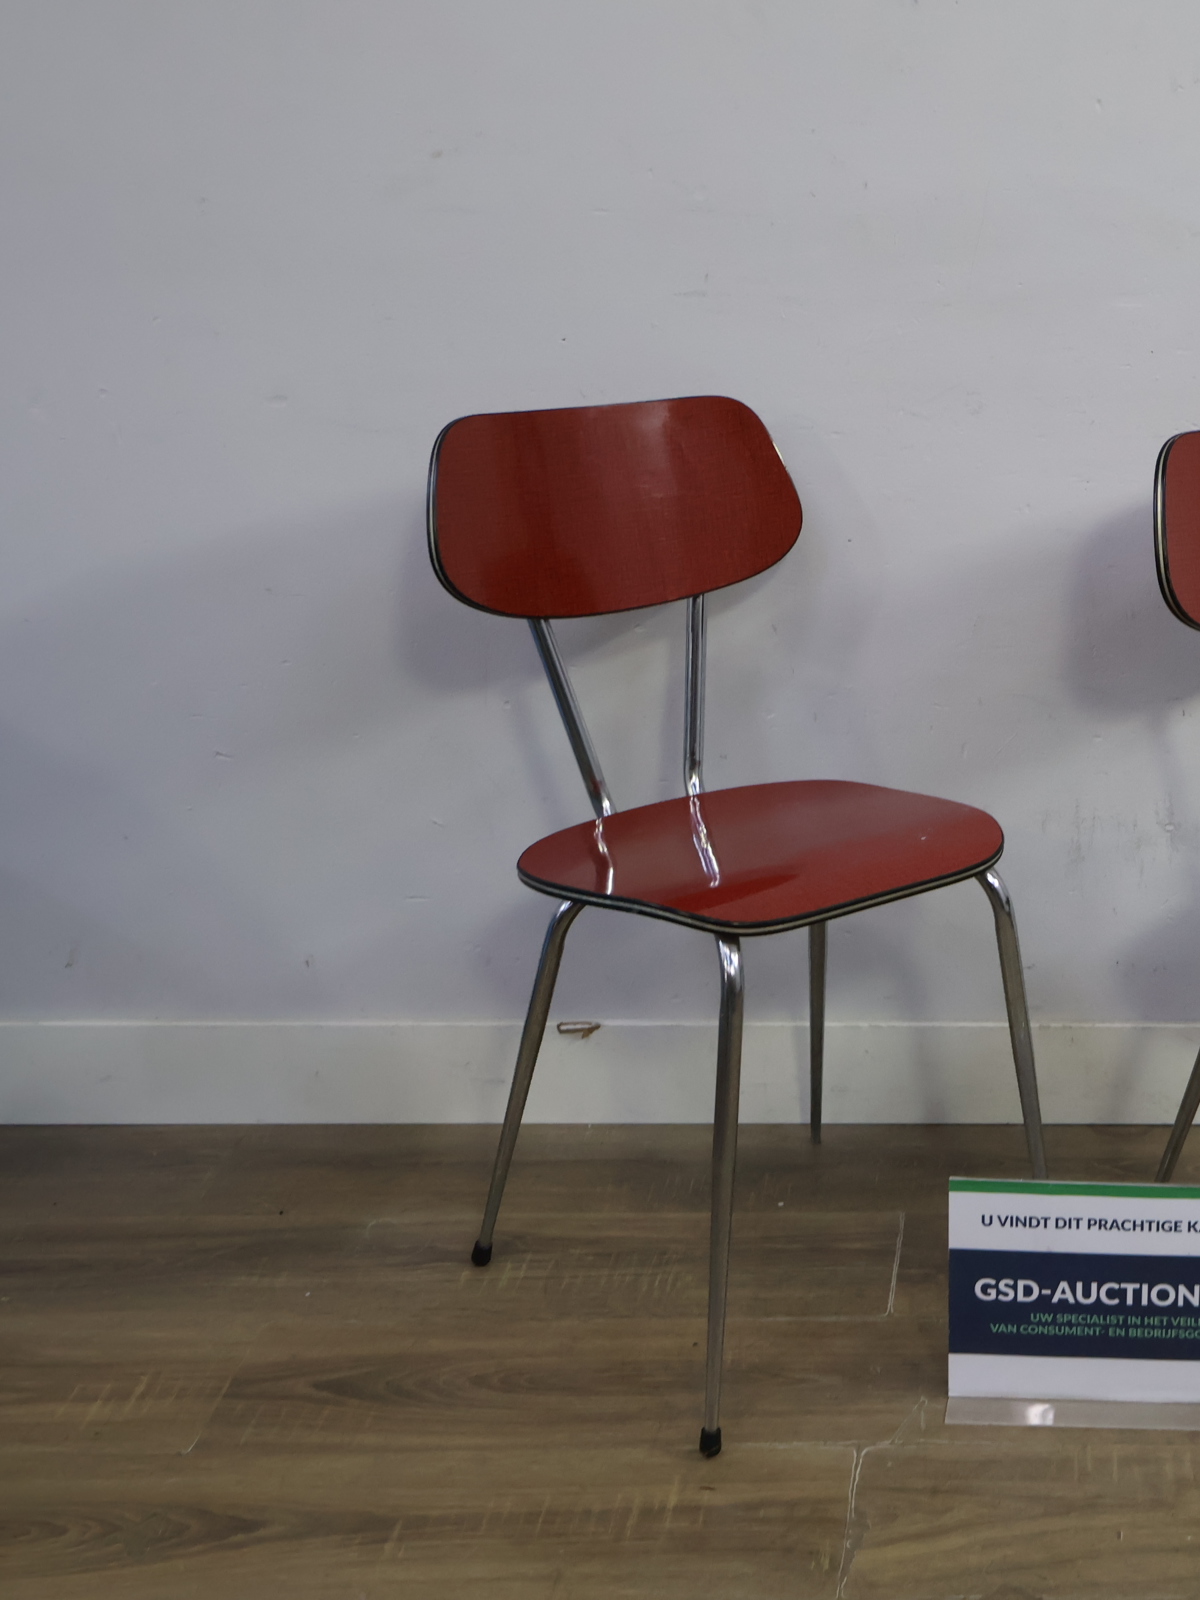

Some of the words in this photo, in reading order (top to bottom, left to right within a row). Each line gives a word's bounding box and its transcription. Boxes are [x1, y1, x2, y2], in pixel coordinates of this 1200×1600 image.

[981, 1214, 993, 1227] U
[997, 1215, 1051, 1229] VINDT
[1055, 1217, 1083, 1230] DIT
[1087, 1217, 1183, 1233] PRACHTIGE
[1030, 1312, 1054, 1323] UW
[1056, 1313, 1125, 1325] SPECIALIST
[1127, 1315, 1141, 1325] IN
[1144, 1315, 1168, 1326] HET
[990, 1323, 1017, 1334] VAN
[1020, 1324, 1105, 1336] CONSUMENT-
[1108, 1327, 1125, 1337] EN
